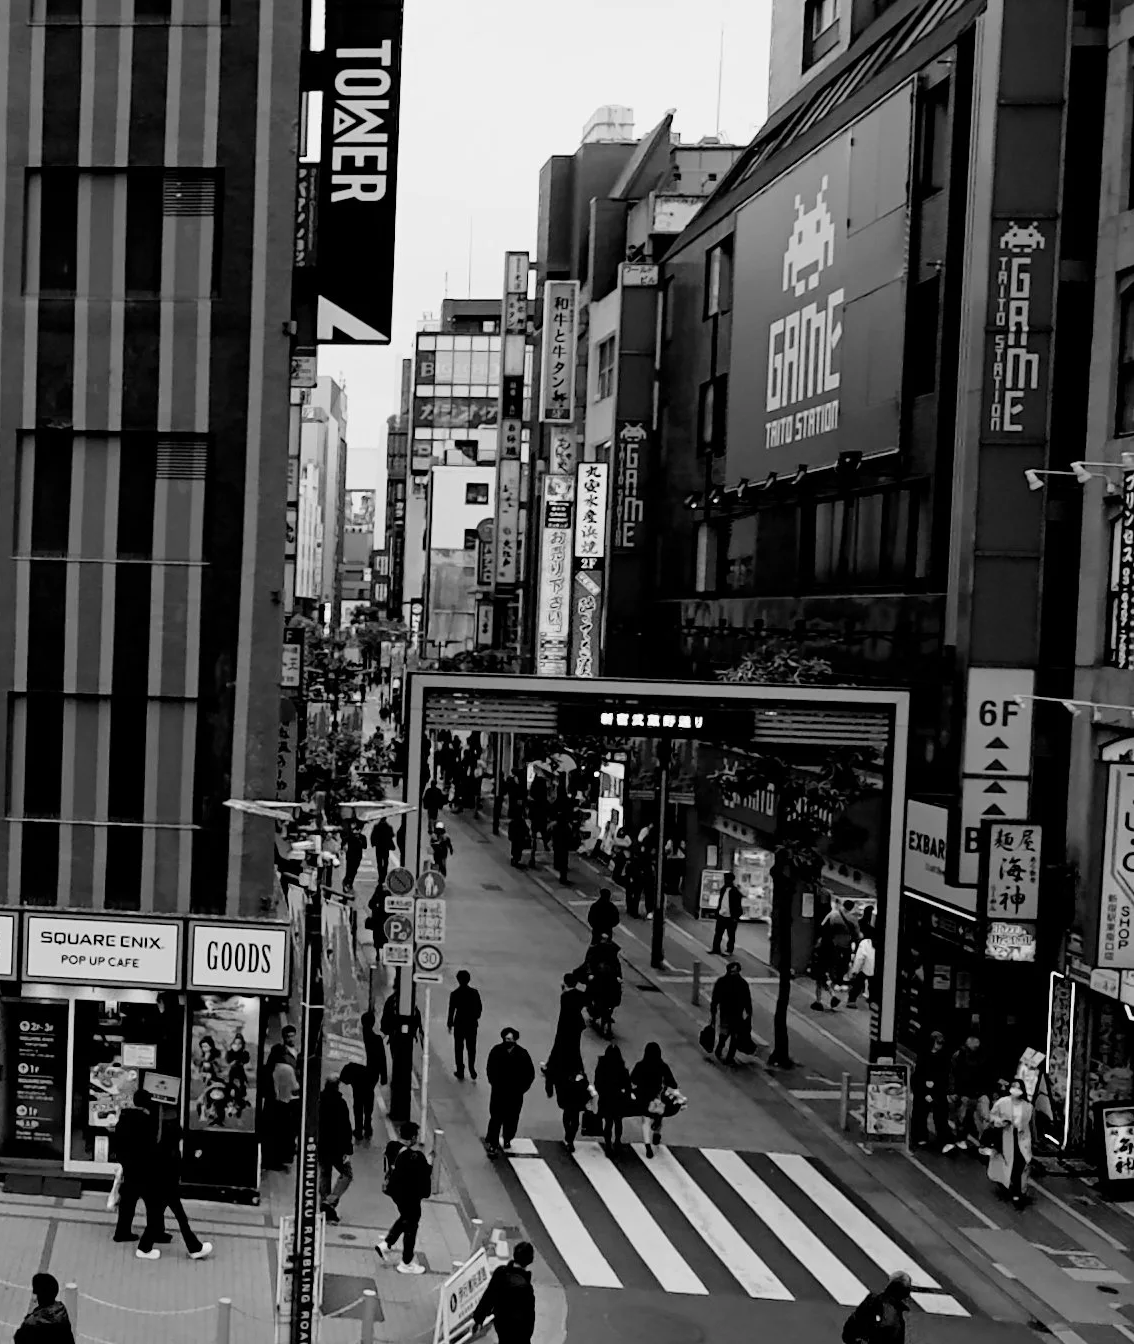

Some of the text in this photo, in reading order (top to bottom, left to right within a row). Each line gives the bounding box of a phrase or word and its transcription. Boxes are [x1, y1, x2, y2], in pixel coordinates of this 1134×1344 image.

[331, 40, 392, 204] TOWER
[767, 288, 845, 413] GAME
[990, 257, 1008, 431] TAITO STATION
[1003, 257, 1039, 432] GAME
[794, 400, 839, 442] STATION
[623, 444, 643, 547] GAME
[581, 559, 597, 570] 2F
[979, 701, 1019, 727] 6F
[909, 830, 946, 860] EXBAR
[998, 856, 1027, 915] 海神
[41, 931, 162, 949] SQUARE ENIX
[1119, 906, 1130, 950] SHOP
[61, 954, 140, 968] POP UP CAFE
[207, 941, 272, 973] GOODS
[420, 952, 437, 964] 30
[304, 1143, 316, 1218] SHINJUKU
[301, 1226, 313, 1303] RAMBLING
